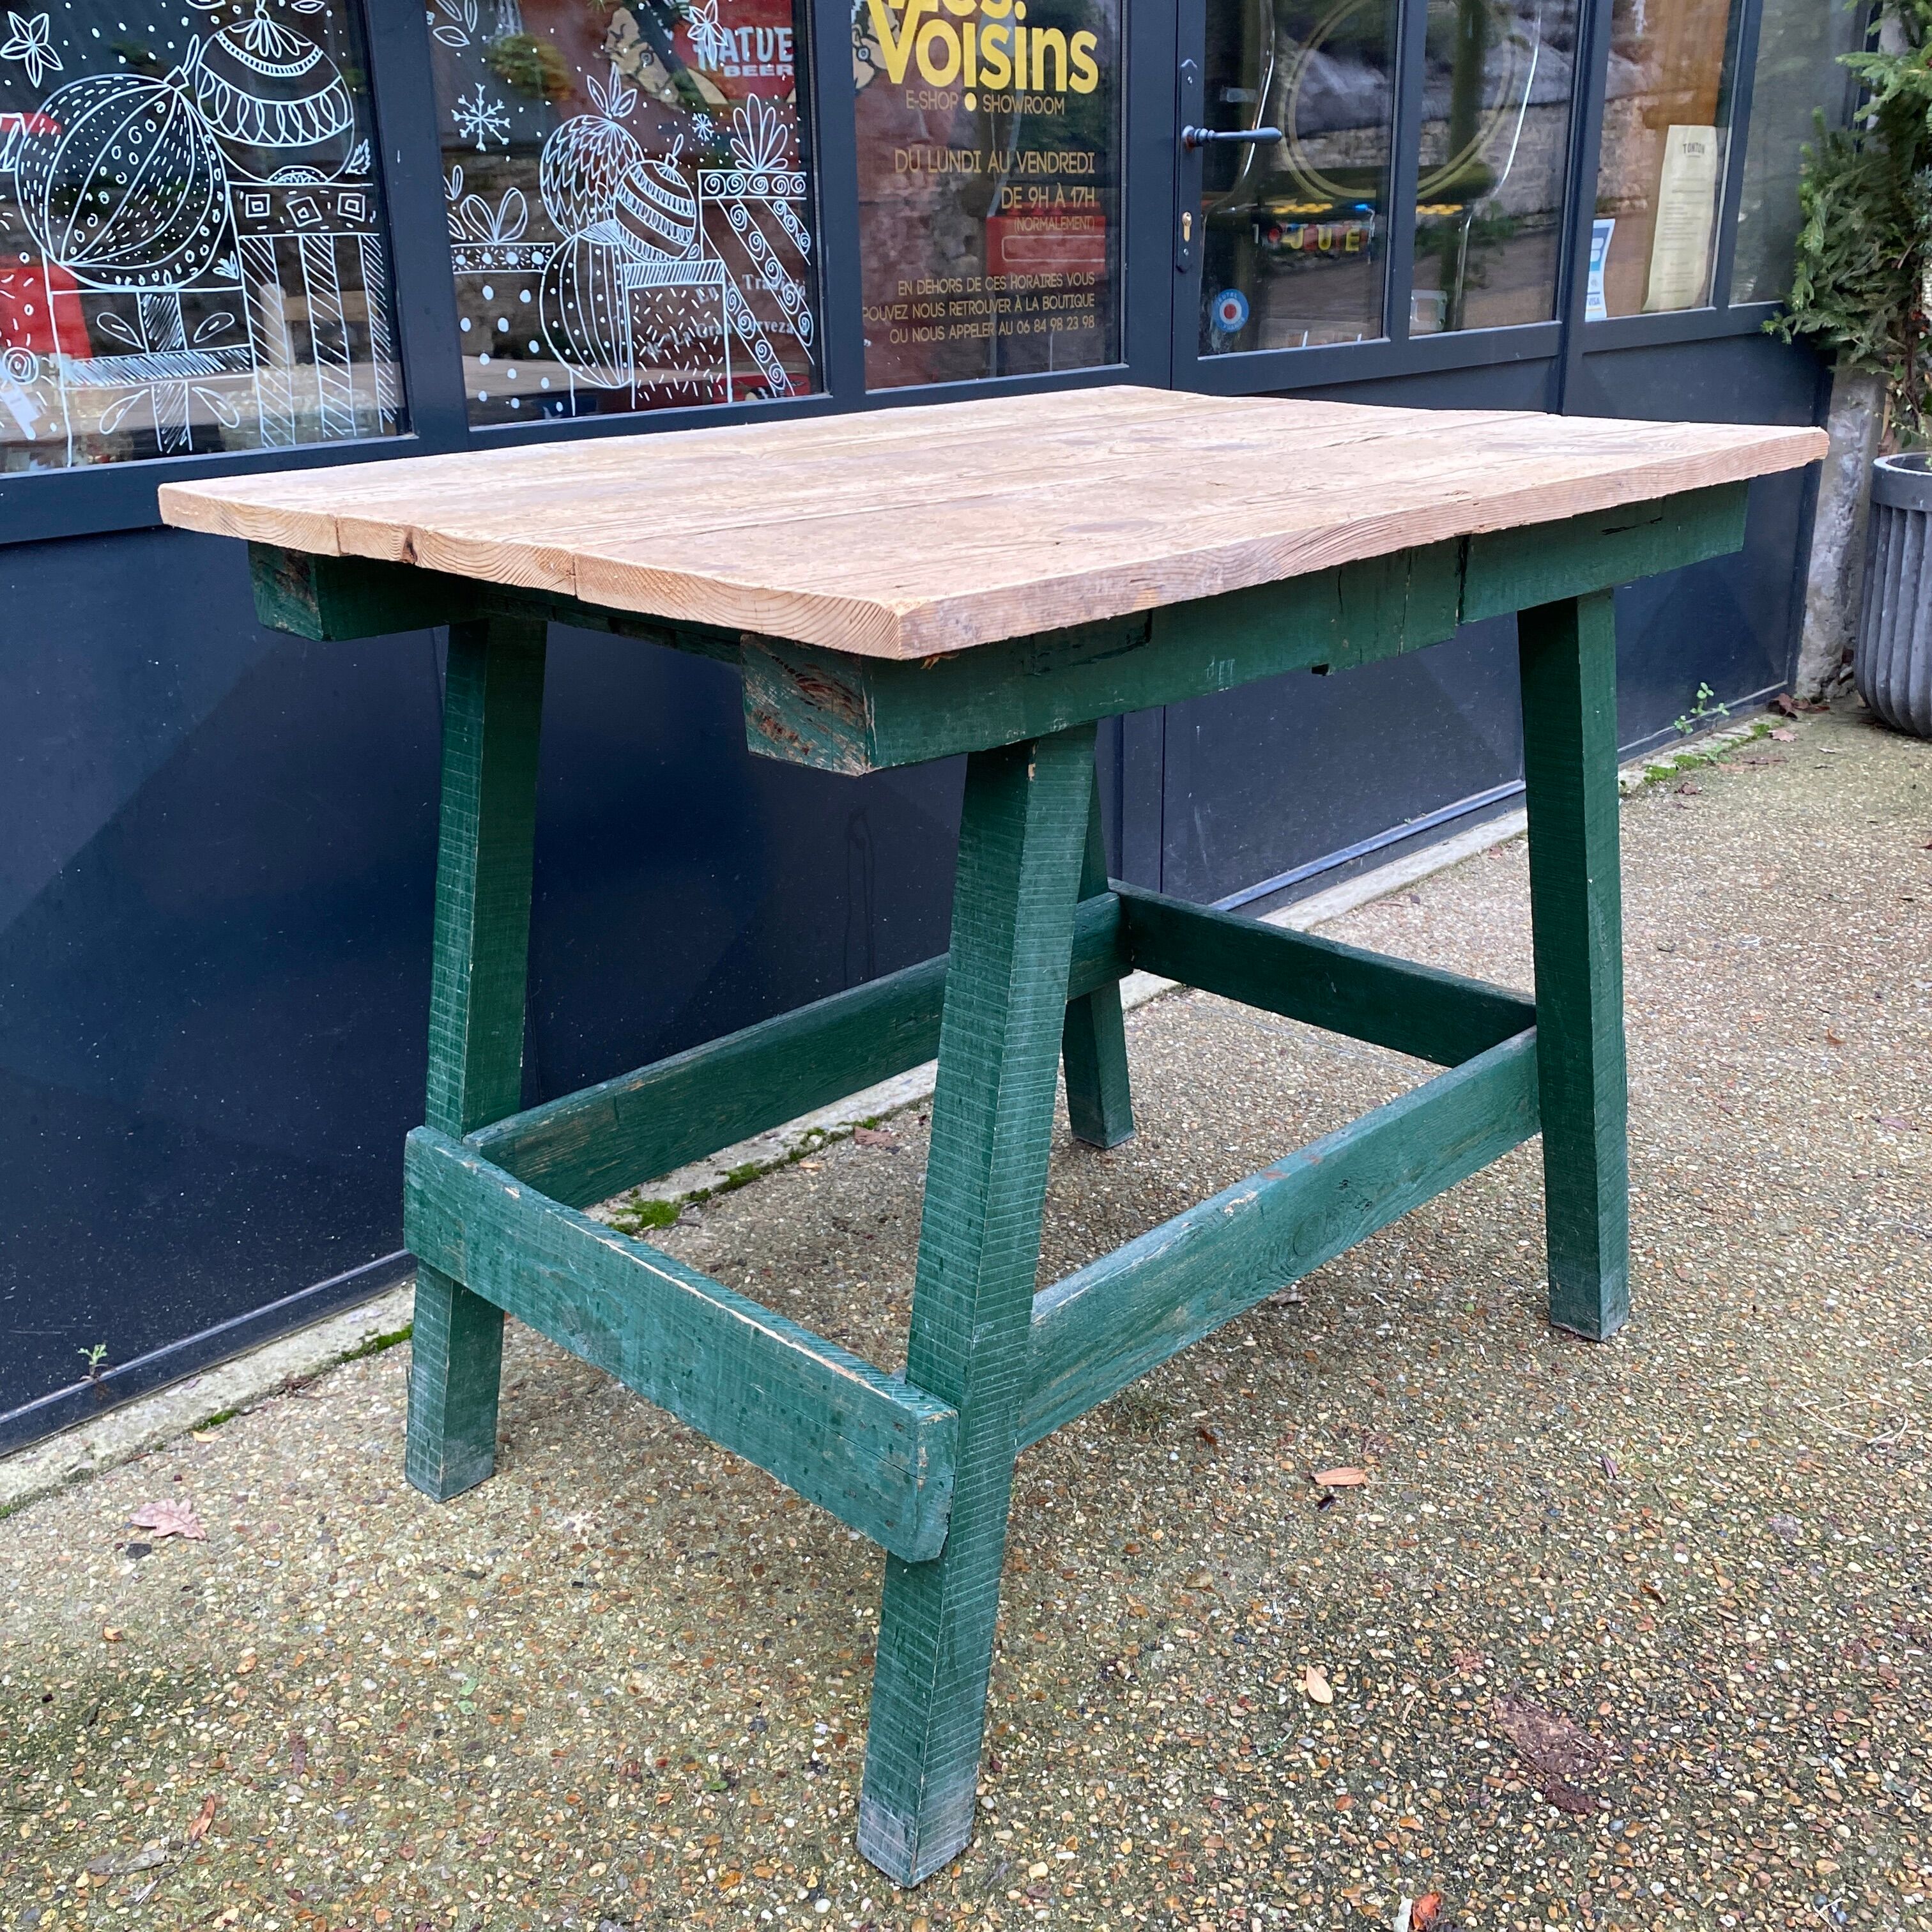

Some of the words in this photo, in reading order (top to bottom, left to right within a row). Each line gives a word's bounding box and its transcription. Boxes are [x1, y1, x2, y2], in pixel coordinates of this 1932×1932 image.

[865, 0, 1099, 111] Voisins
[723, 65, 794, 77] BEER
[905, 89, 958, 111] E-SHOP
[983, 94, 1065, 115] SHOWROOM
[894, 148, 921, 173] DU
[928, 149, 982, 173] LUNDI
[987, 150, 1011, 174] AU
[1016, 151, 1096, 174] VENDREDI
[1001, 186, 1023, 209] DE
[1028, 186, 1049, 208] 9H
[1054, 182, 1066, 208] À
[1070, 186, 1095, 208] 17H
[1014, 215, 1096, 234] (NORMALEMENT)
[898, 280, 913, 296] EN
[917, 277, 963, 295] DEHORS
[967, 277, 982, 292] DE
[985, 276, 1007, 291] CES
[1010, 273, 1063, 289] HORAIRES
[1066, 272, 1095, 287] VOUS
[862, 304, 908, 321] POUVEZ
[912, 302, 945, 319] NOUS
[949, 298, 1011, 317] RETROUVER
[1015, 295, 1022, 312] À
[1025, 296, 1039, 311] LA
[1043, 293, 1095, 310] BOUTIQUE
[889, 328, 908, 344] OU
[912, 326, 945, 342] NOUS
[949, 321, 995, 339] APPELER
[999, 321, 1013, 336] AU
[1017, 319, 1030, 334] 06
[1034, 318, 1046, 333] 84
[1050, 317, 1063, 332] 98
[1066, 316, 1079, 330] 23
[1082, 315, 1095, 329] 98
